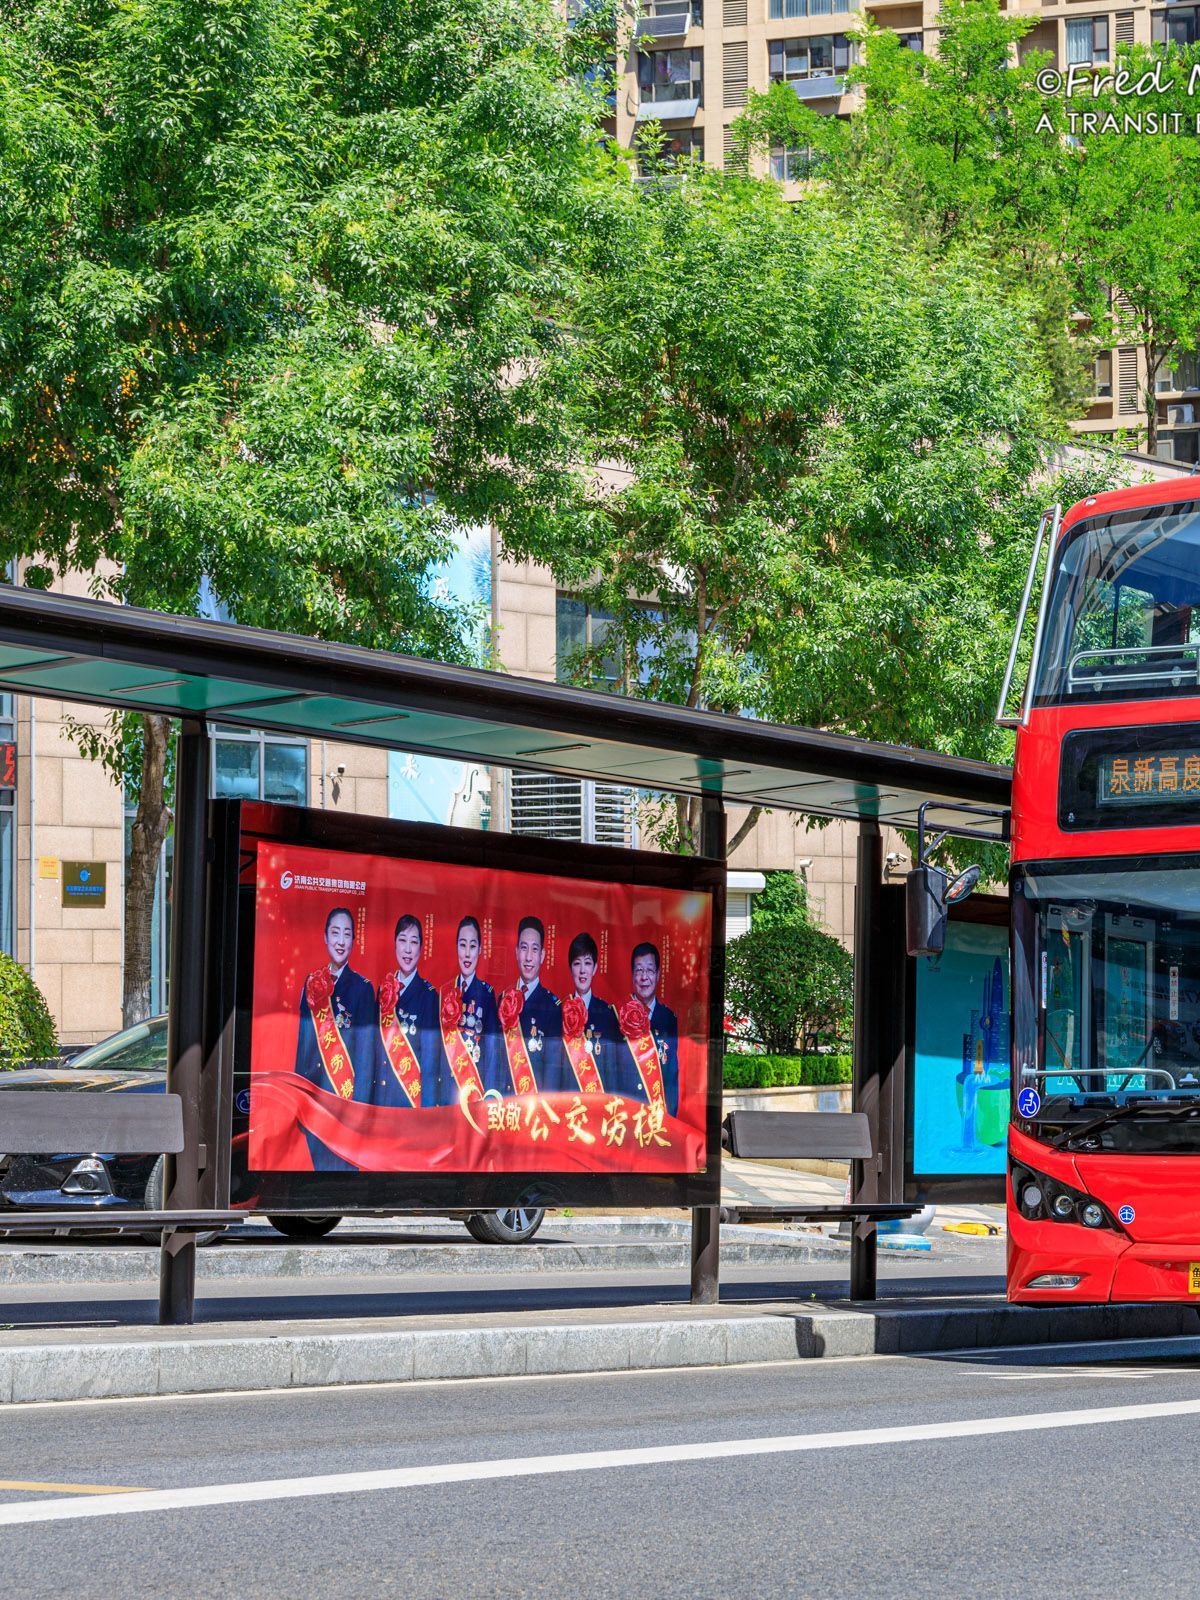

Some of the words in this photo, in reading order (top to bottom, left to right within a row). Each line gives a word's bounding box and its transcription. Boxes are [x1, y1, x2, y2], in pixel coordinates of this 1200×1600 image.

[316, 1008, 355, 1099] 公交劳模
[382, 1014, 421, 1098] 公交劳模
